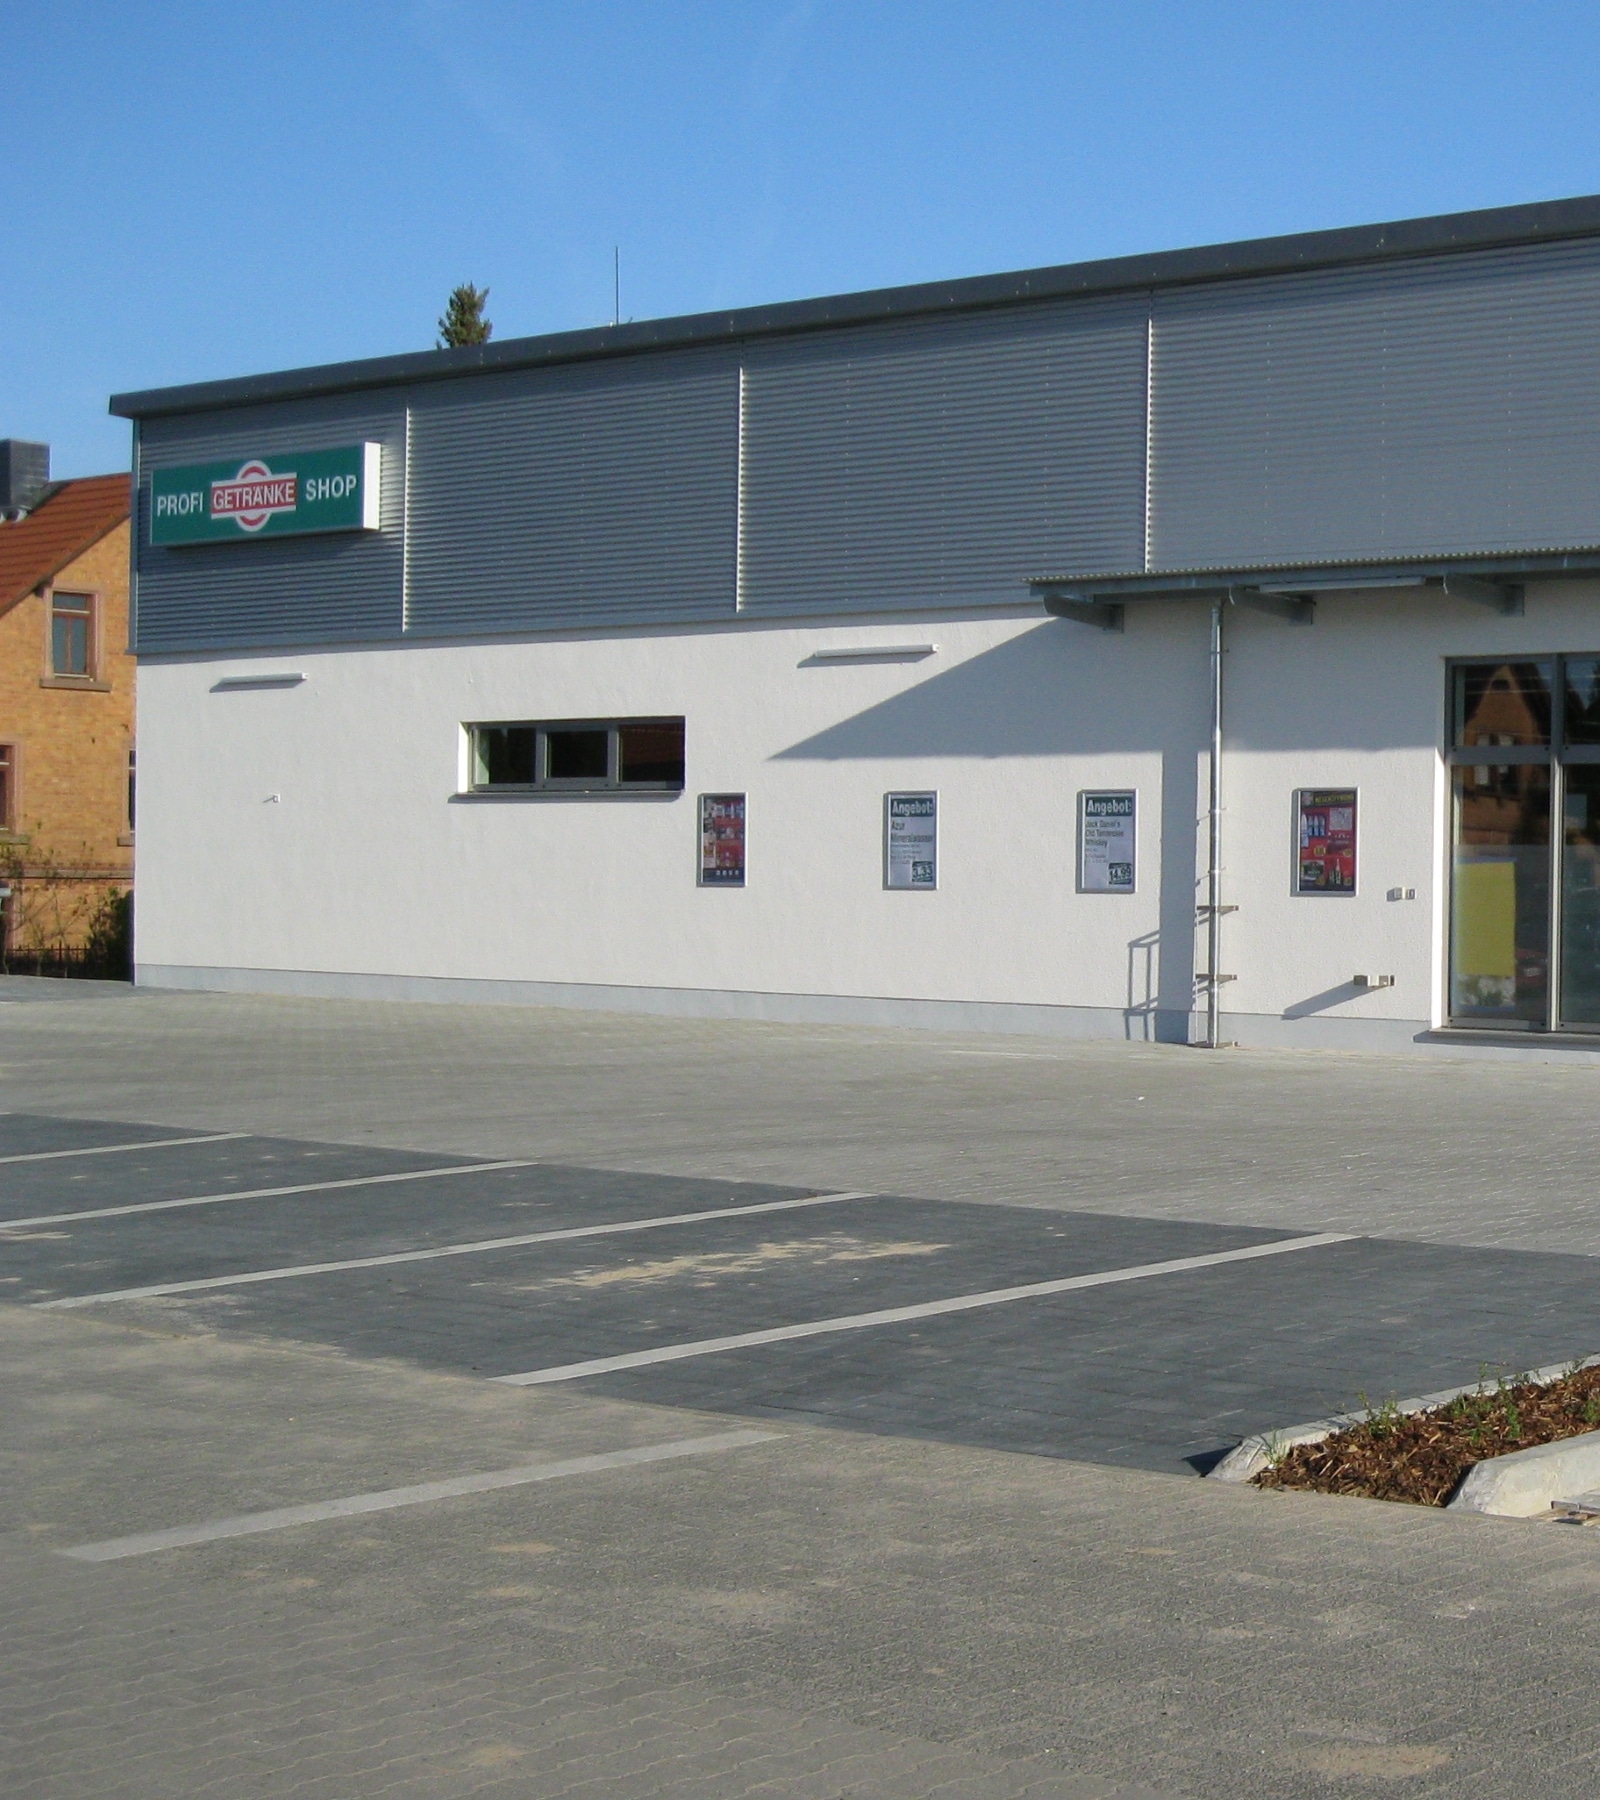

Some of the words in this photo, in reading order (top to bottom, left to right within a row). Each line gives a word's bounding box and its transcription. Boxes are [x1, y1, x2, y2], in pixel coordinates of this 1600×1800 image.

[157, 492, 203, 516] PROFI
[213, 481, 295, 510] GETRÄNKE
[305, 474, 357, 501] SHOP
